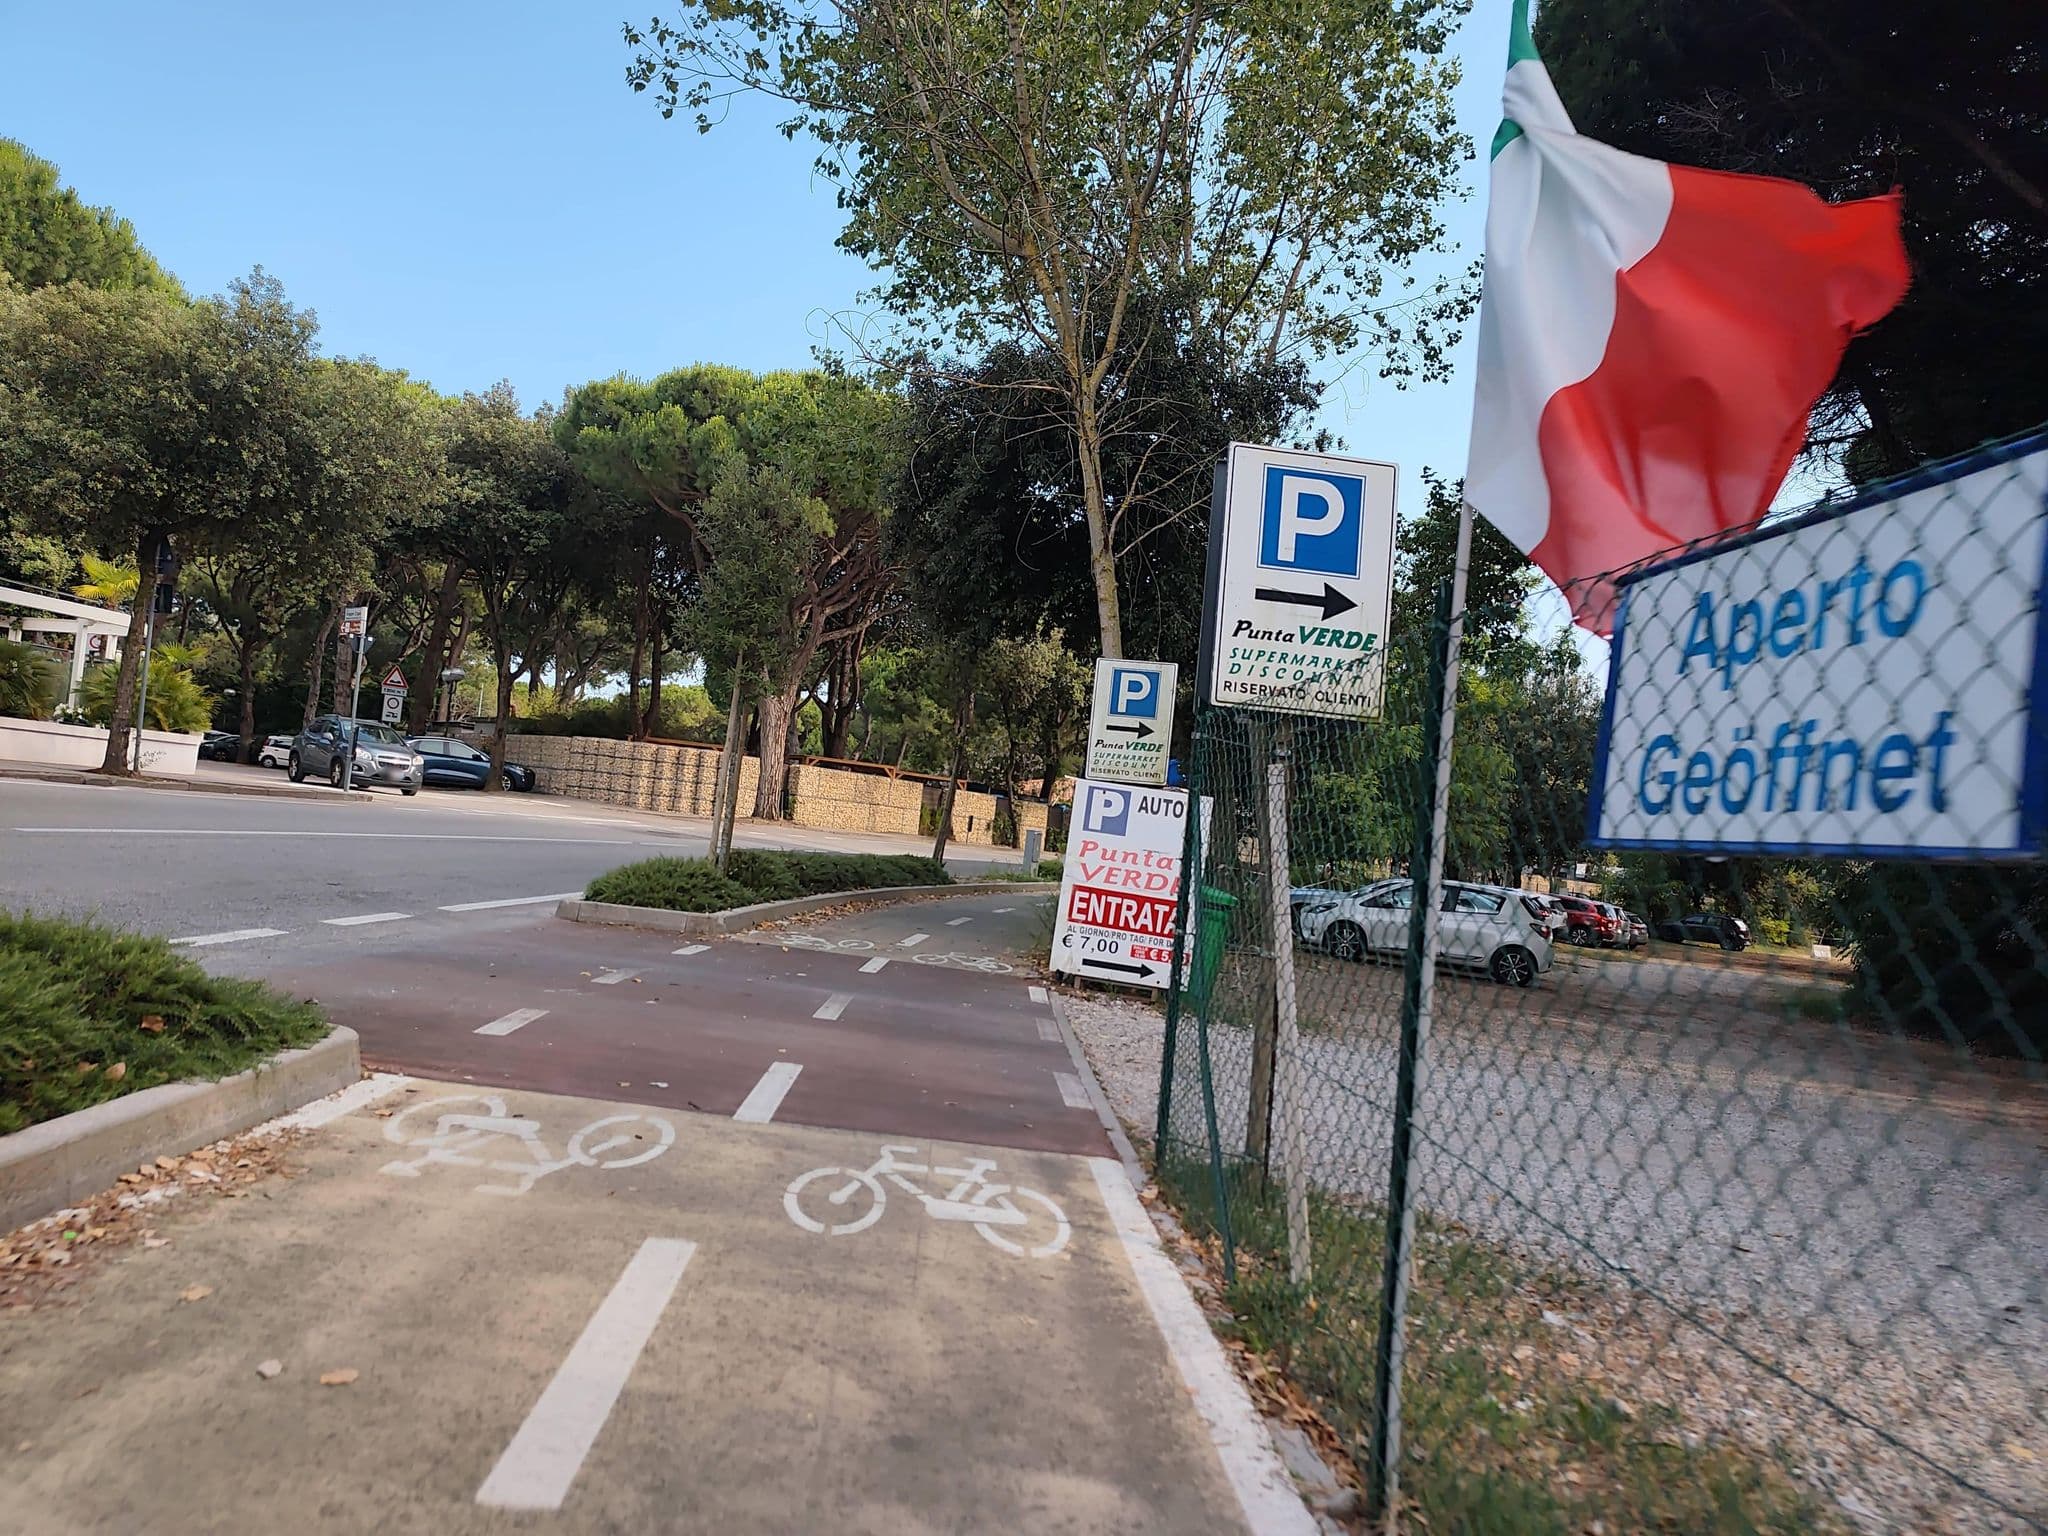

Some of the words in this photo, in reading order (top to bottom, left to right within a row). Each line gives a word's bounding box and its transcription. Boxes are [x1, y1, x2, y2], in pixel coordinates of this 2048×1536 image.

[1277, 474, 1345, 563] P
[1232, 619, 1295, 644] Punta
[1299, 625, 1378, 651] VERDE
[1679, 553, 1926, 692] Aperto
[1229, 647, 1369, 670] SUPERMARKET
[1228, 662, 1362, 688] DISCOUNT
[1117, 672, 1151, 713] P
[1223, 680, 1306, 701] RISERVATO
[1314, 690, 1372, 708] CLIENTI
[1093, 751, 1161, 763] SUPERMARKET
[1094, 739, 1124, 750] Punta
[1125, 741, 1164, 753] VERDE
[1090, 767, 1130, 776] RISERVATO
[1133, 770, 1162, 779] CLIENTI
[1093, 760, 1157, 770] DISCOUNT
[1638, 711, 1959, 816] Geöffnet
[1088, 789, 1124, 831] P
[1137, 795, 1185, 819] AUTO
[1079, 840, 1174, 871] Punta
[1062, 933, 1074, 949] €
[1081, 936, 1119, 954] 7,00
[1067, 925, 1077, 934] AL
[1148, 937, 1164, 947] FOR
[1149, 949, 1159, 960] €
